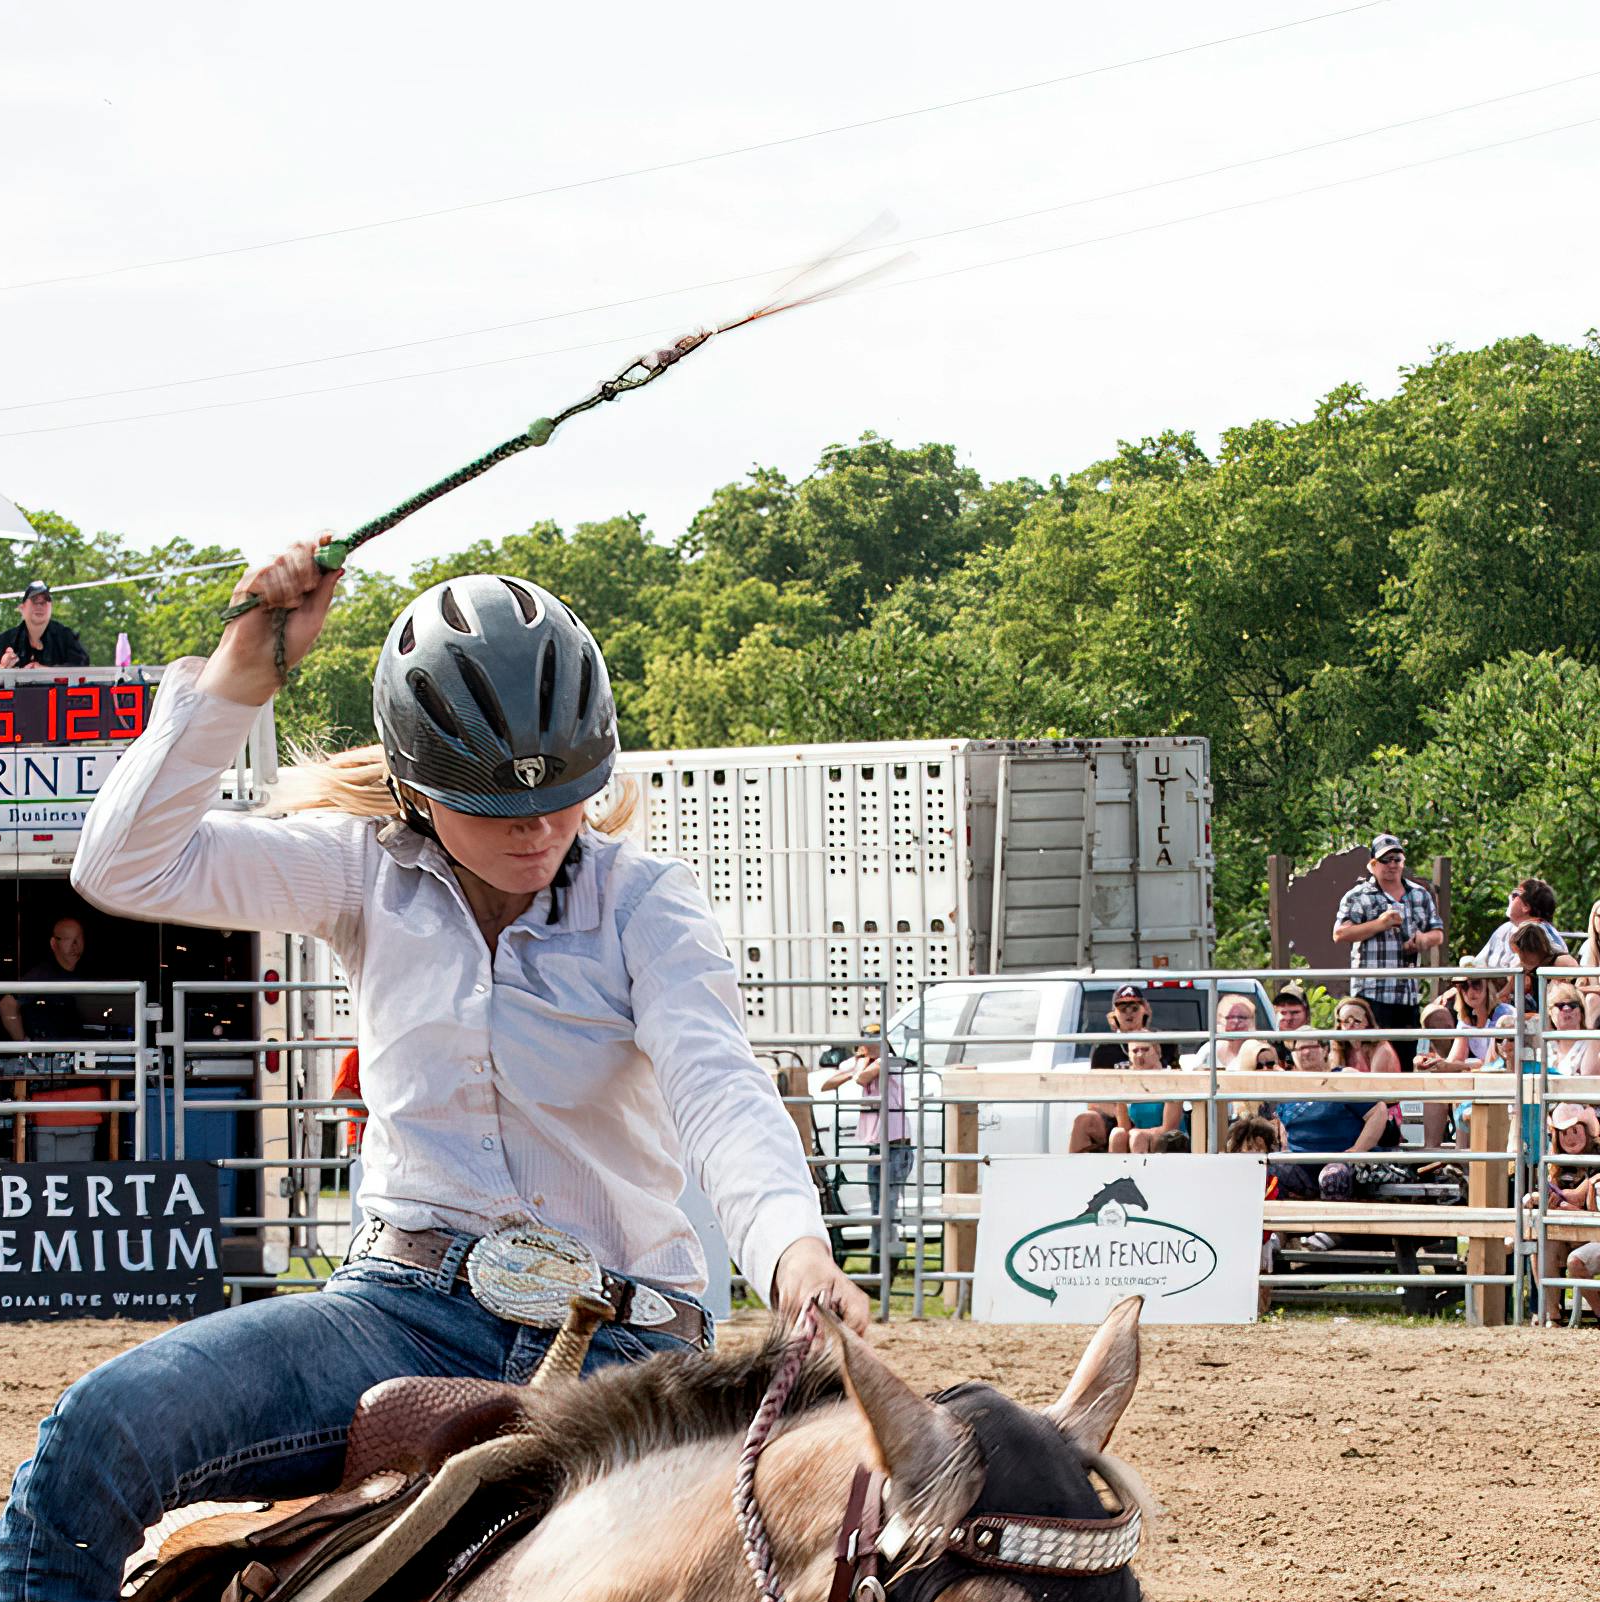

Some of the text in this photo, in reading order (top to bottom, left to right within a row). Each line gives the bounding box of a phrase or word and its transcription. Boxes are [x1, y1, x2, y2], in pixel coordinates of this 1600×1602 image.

[1145, 756, 1179, 865] UTICA
[1027, 1238, 1197, 1273] SYSTEM FENCING
